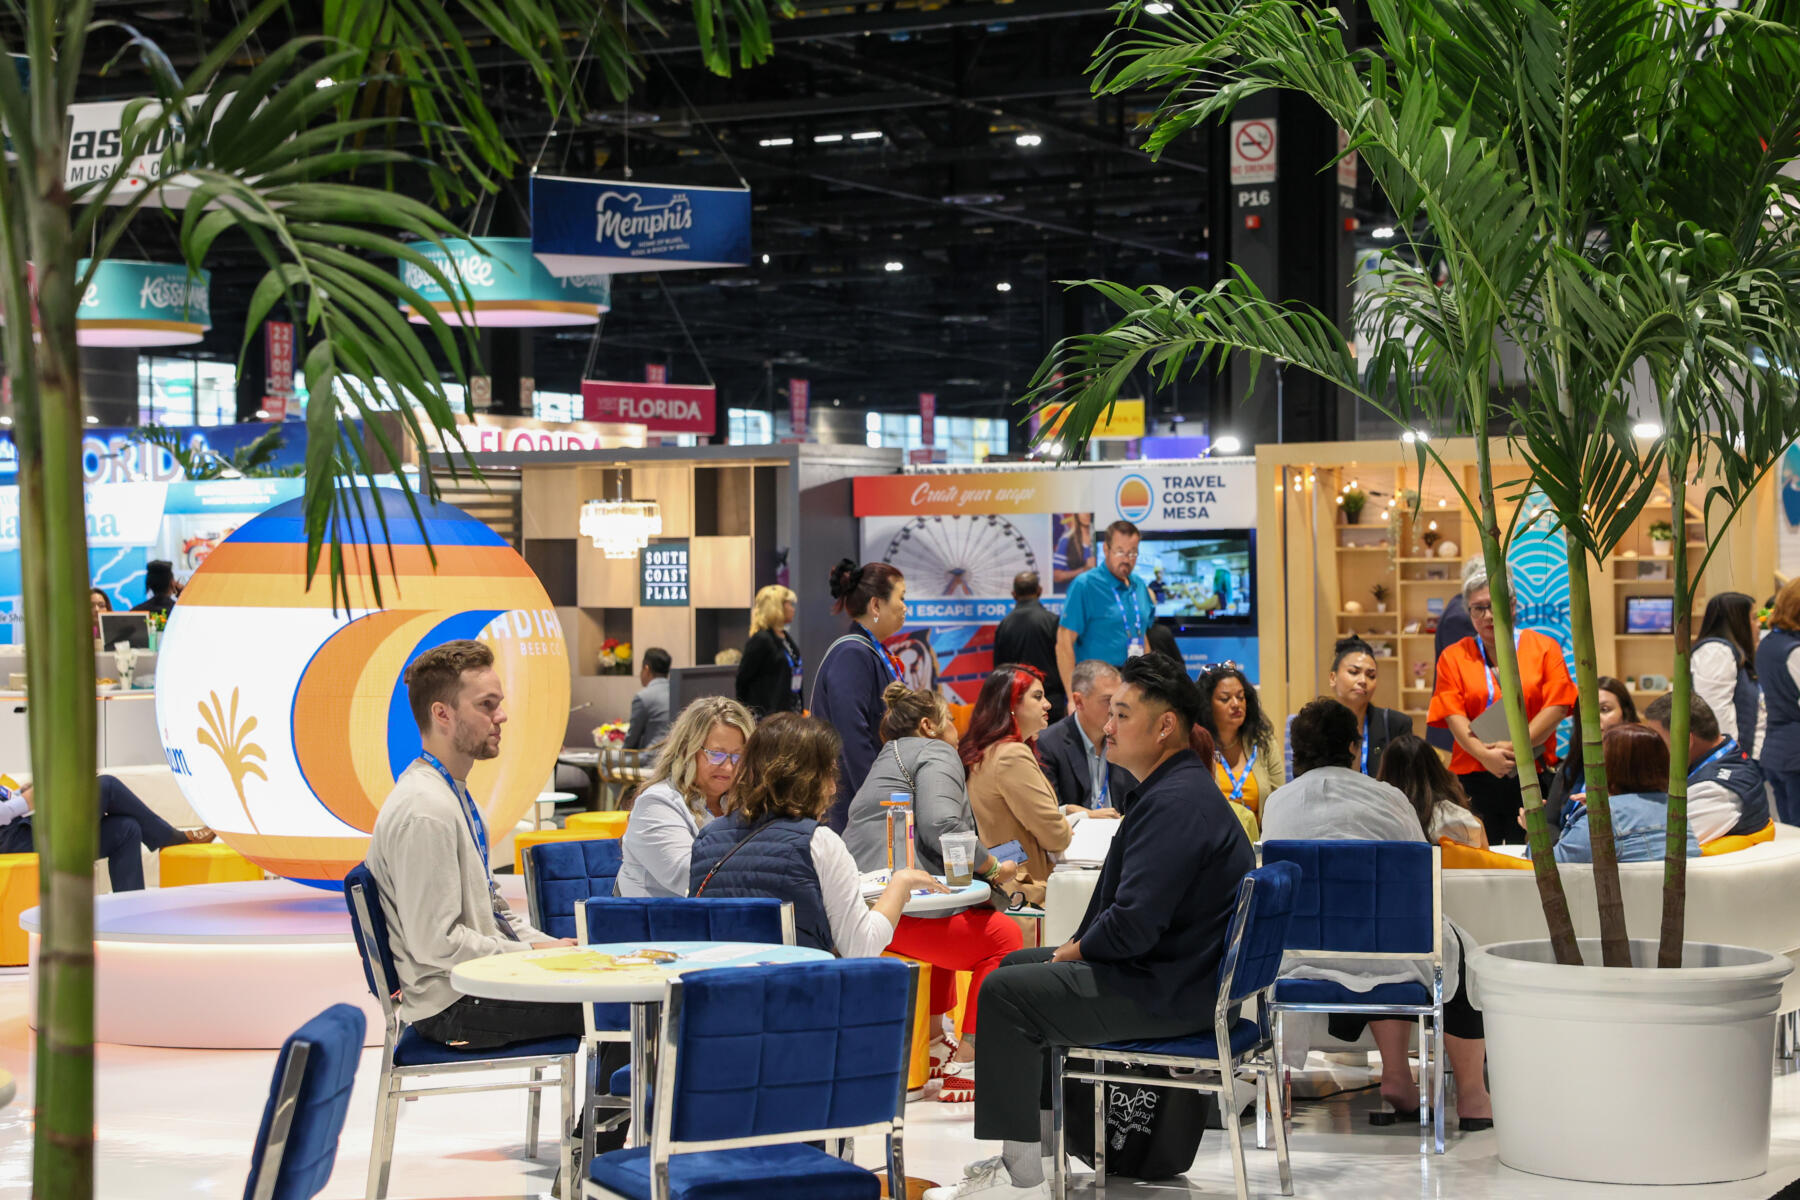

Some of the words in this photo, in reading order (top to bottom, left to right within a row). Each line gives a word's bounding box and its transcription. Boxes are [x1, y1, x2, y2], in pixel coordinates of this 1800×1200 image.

[1238, 190, 1270, 207] P16
[596, 205, 692, 249] Memphis
[618, 398, 702, 420] FLORIDA
[1162, 475, 1226, 489] TRAVEL
[910, 481, 957, 506] Create
[957, 489, 992, 507] your
[1163, 491, 1217, 504] COSTA
[1163, 506, 1209, 519] MESA
[645, 551, 687, 565] SOUTH
[645, 568, 687, 583] COAST
[645, 586, 687, 600] PLAZA
[917, 605, 974, 617] ESCAPE
[977, 604, 1006, 617] FOR
[520, 642, 548, 656] BEER
